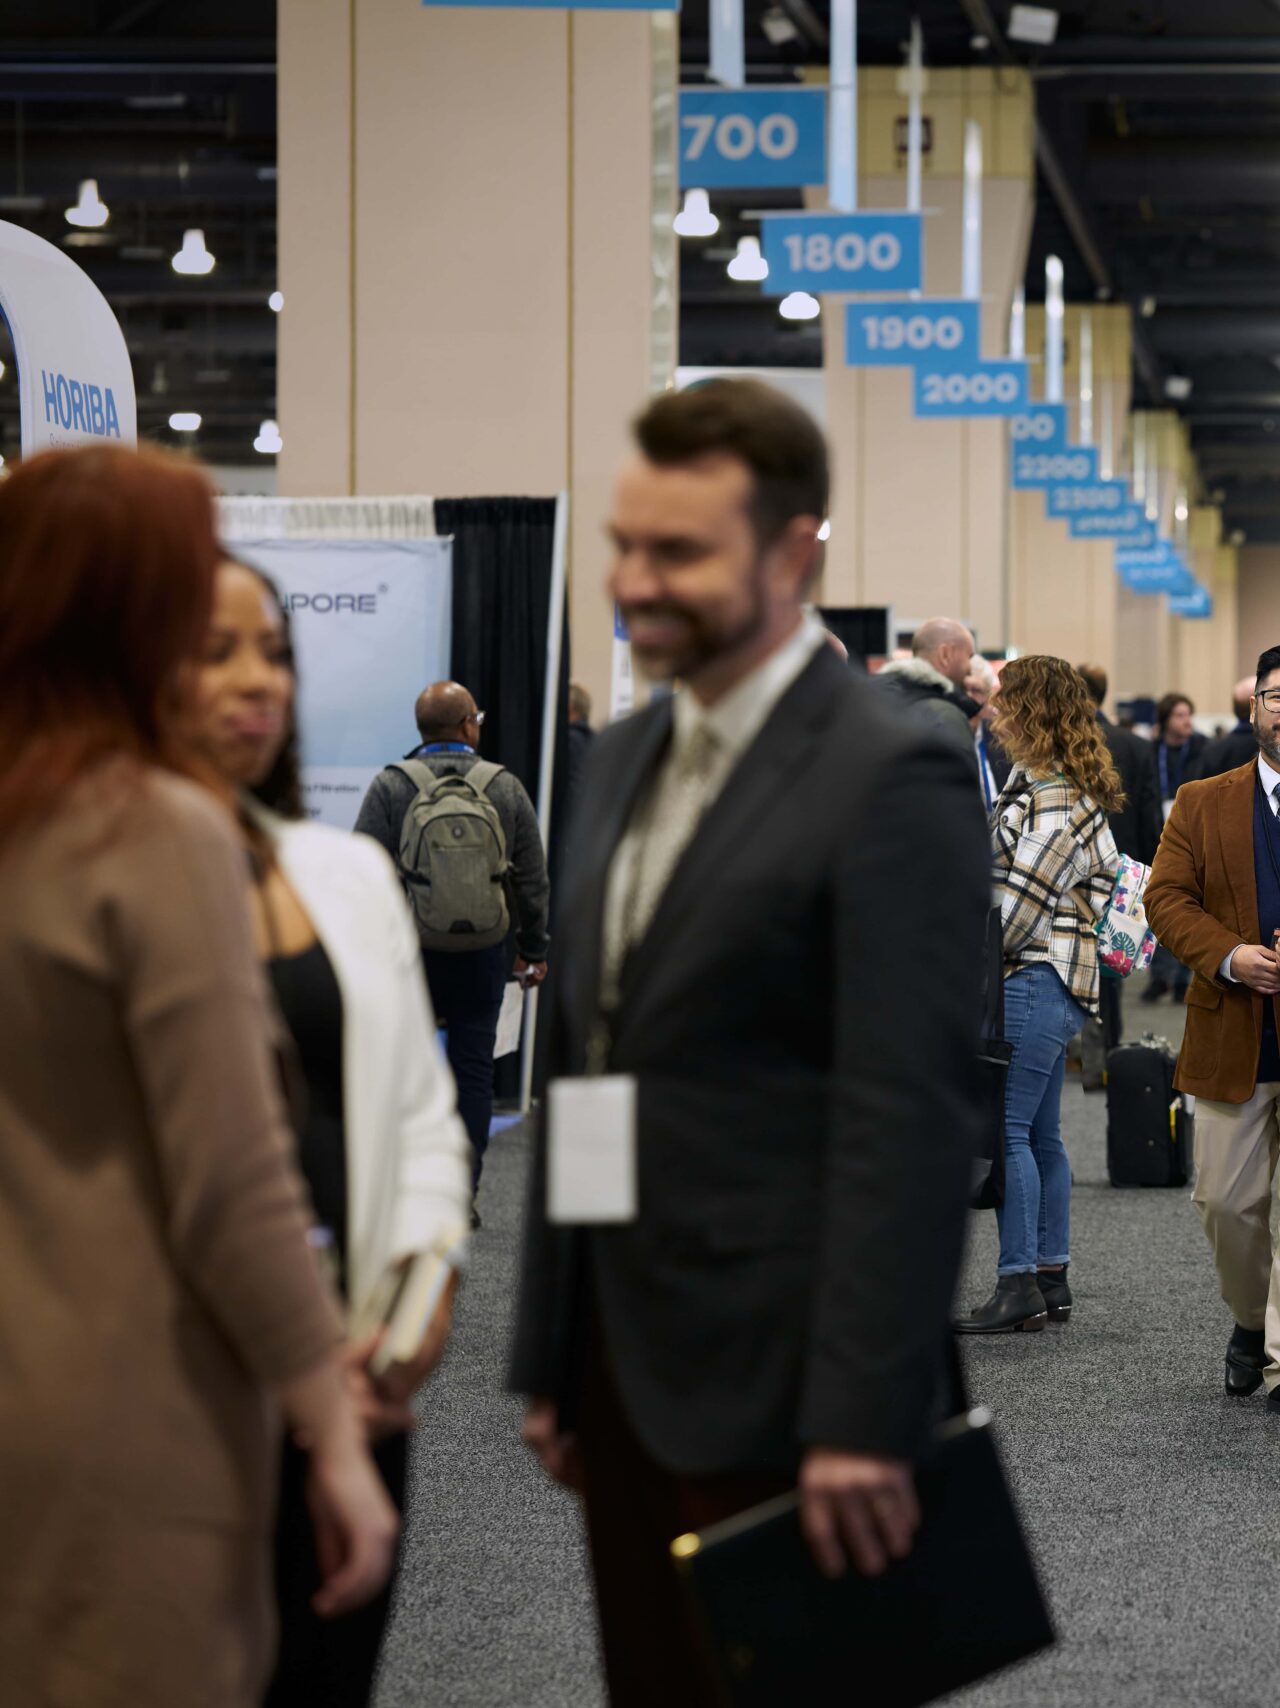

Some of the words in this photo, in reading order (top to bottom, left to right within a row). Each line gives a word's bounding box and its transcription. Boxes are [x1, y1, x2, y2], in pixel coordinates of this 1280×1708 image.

[783, 232, 901, 272] 1800
[861, 316, 963, 349] 1900
[41, 368, 121, 439] HORIBA
[922, 373, 1018, 404] 2000
